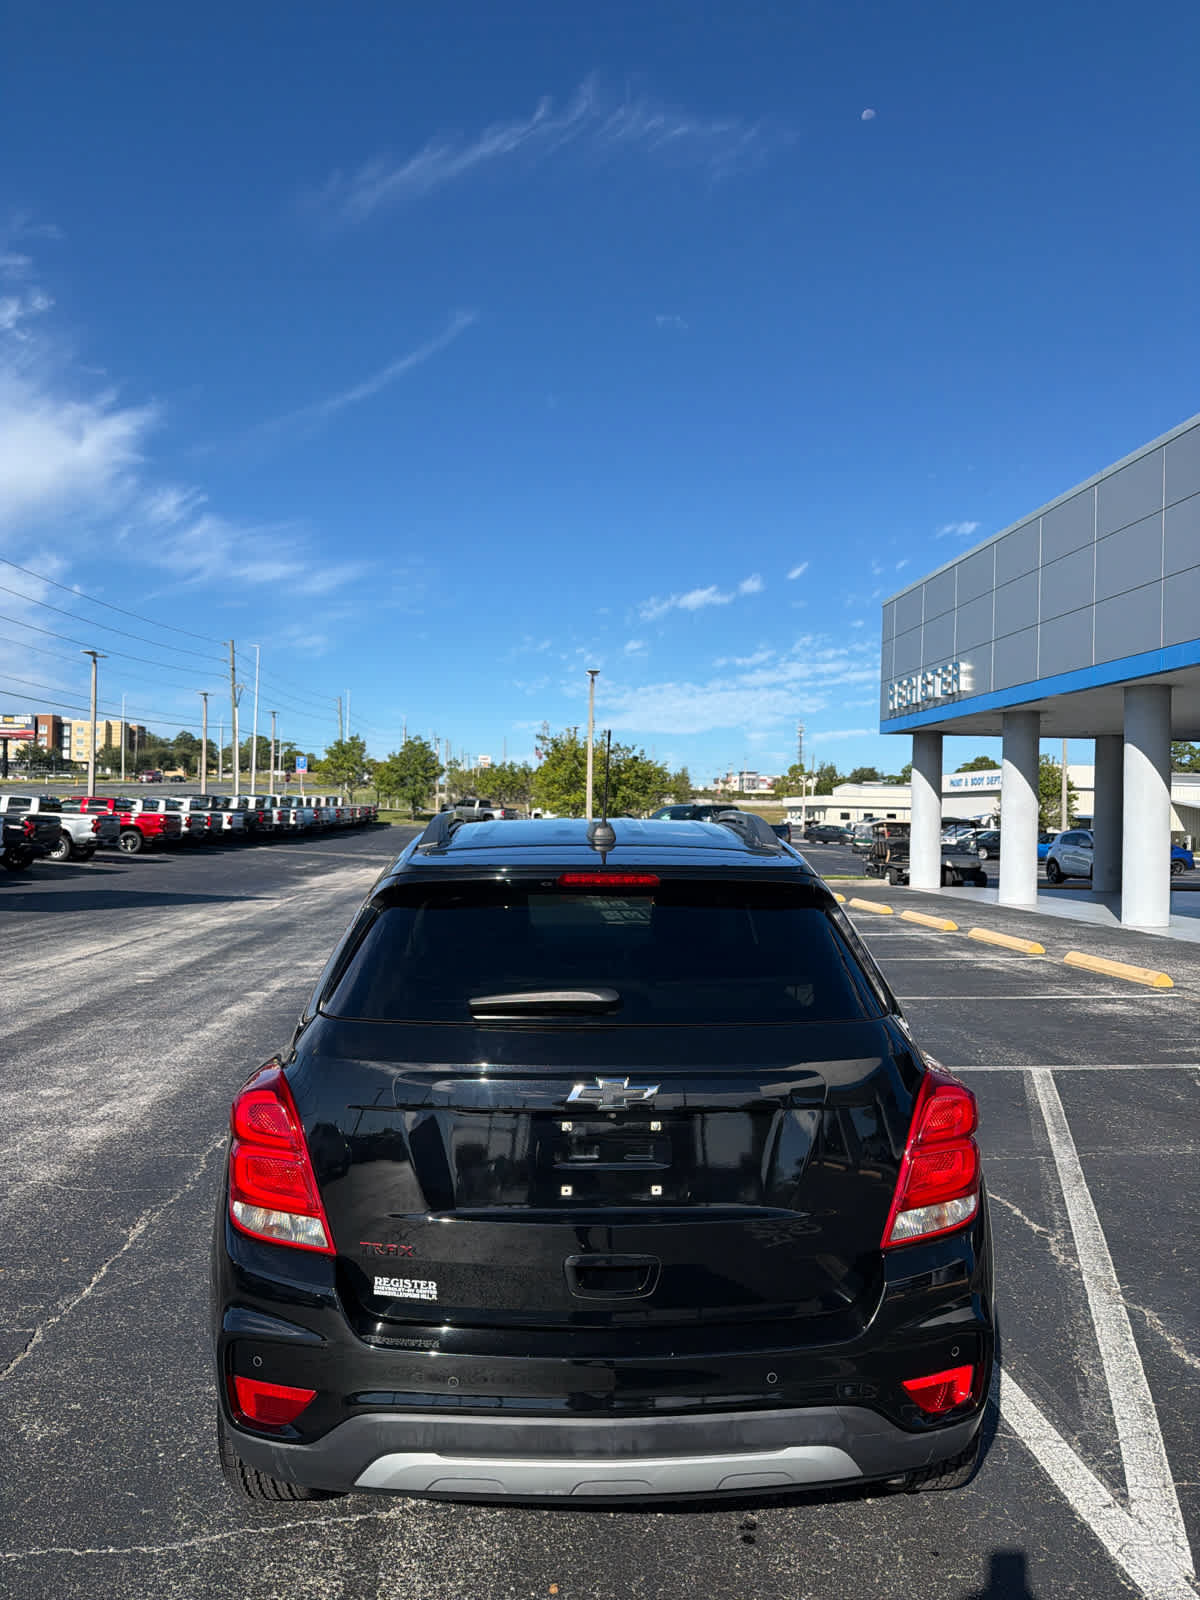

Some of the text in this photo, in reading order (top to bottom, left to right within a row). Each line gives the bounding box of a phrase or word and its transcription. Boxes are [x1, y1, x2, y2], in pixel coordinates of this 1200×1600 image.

[888, 662, 968, 710] REGISTER
[360, 1241, 416, 1257] TRAX
[374, 1276, 437, 1290] REGISTER
